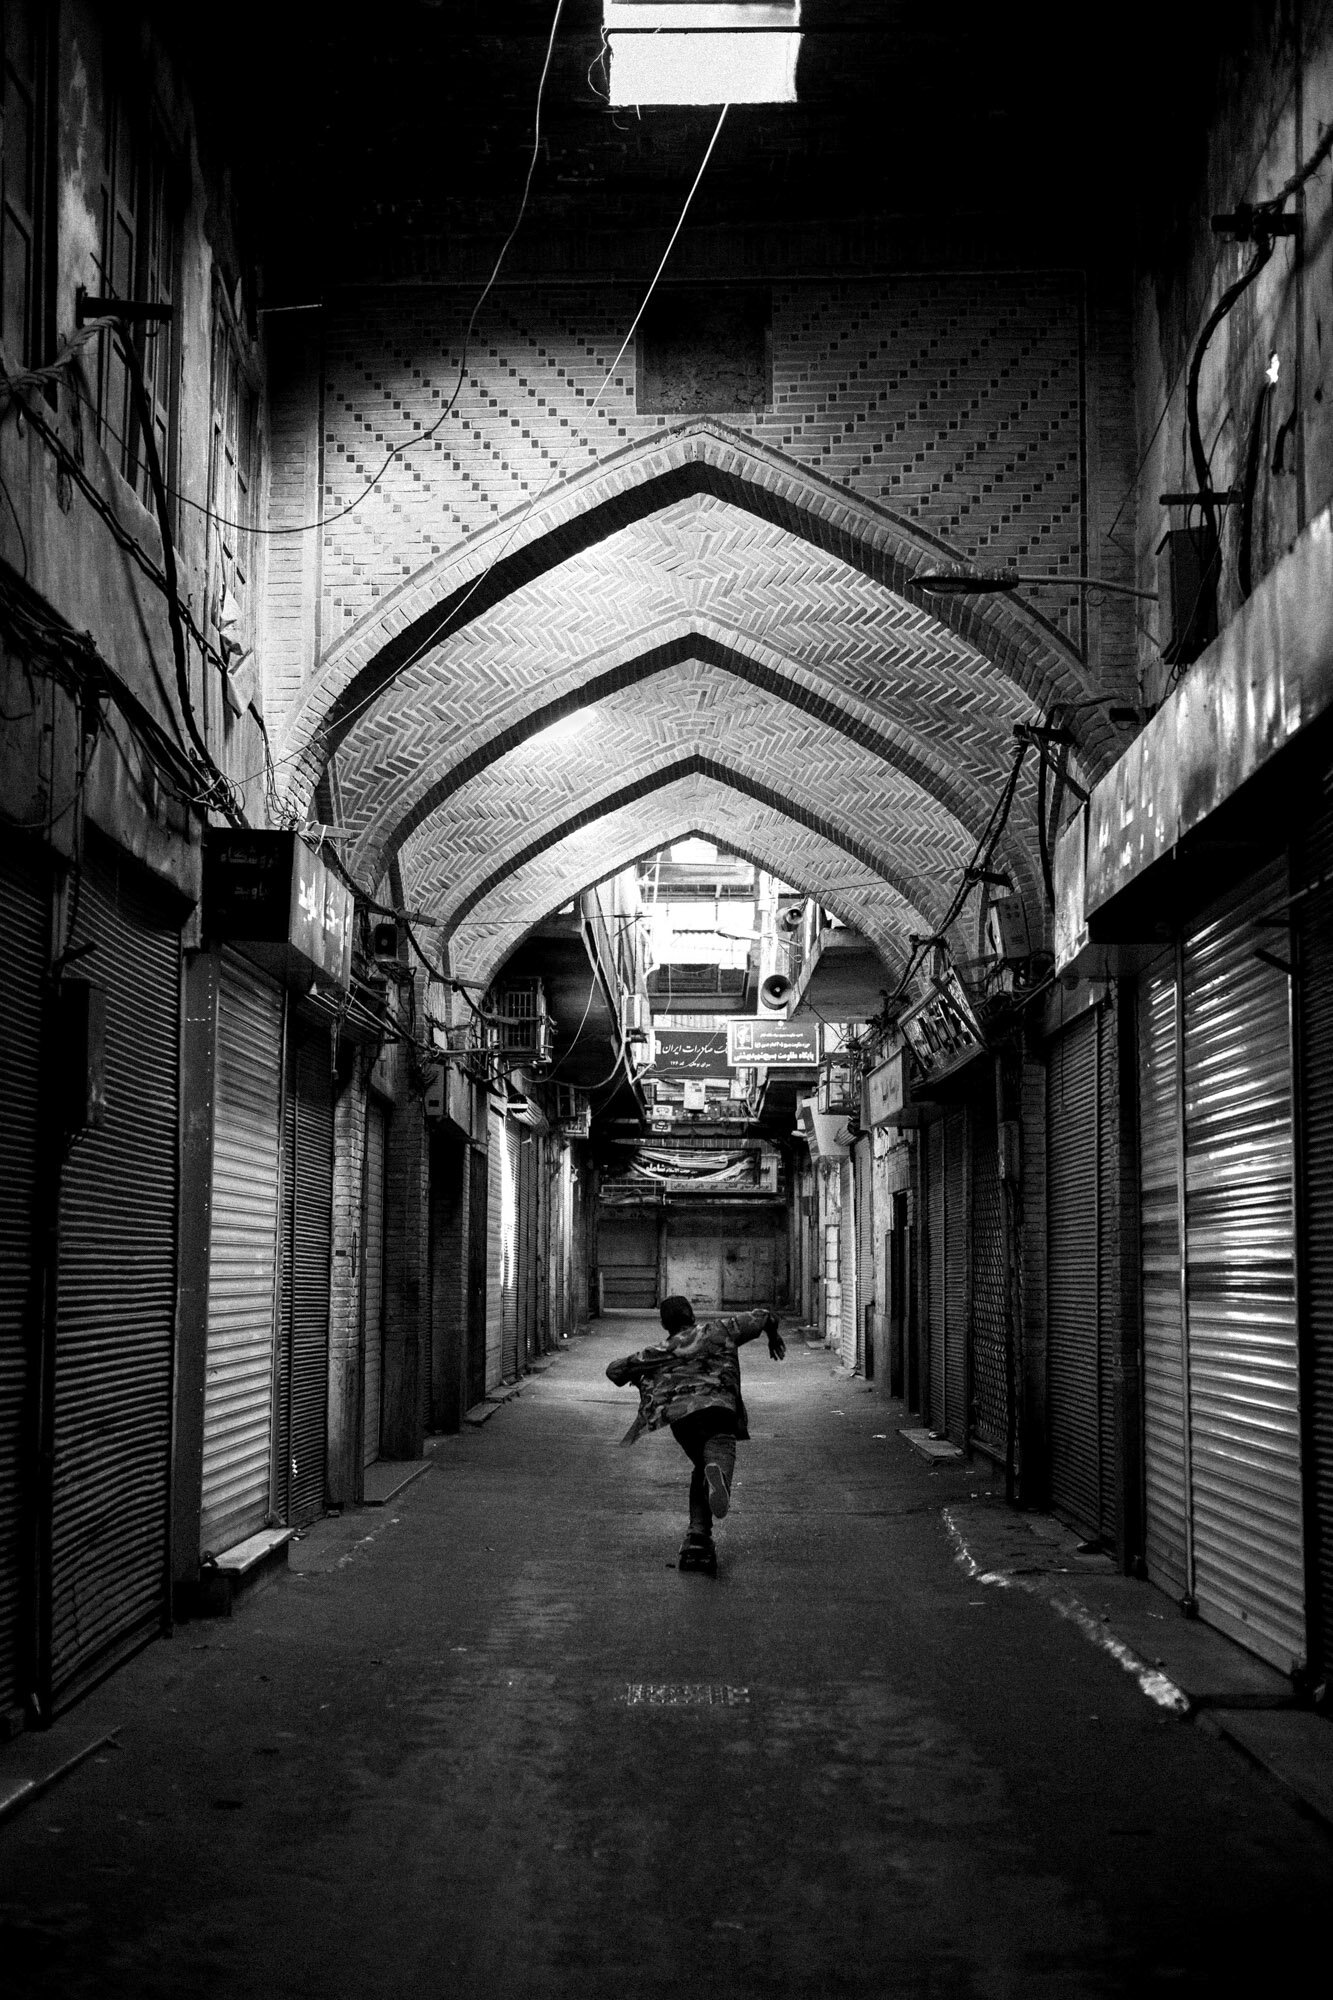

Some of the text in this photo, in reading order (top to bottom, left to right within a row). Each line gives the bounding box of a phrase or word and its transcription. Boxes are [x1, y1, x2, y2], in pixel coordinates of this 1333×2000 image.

[662, 1044, 682, 1055] ایران
[682, 1044, 713, 1054] صادرات
[777, 1051, 798, 1061] مقاومت
[799, 1051, 814, 1061] پایگاه
